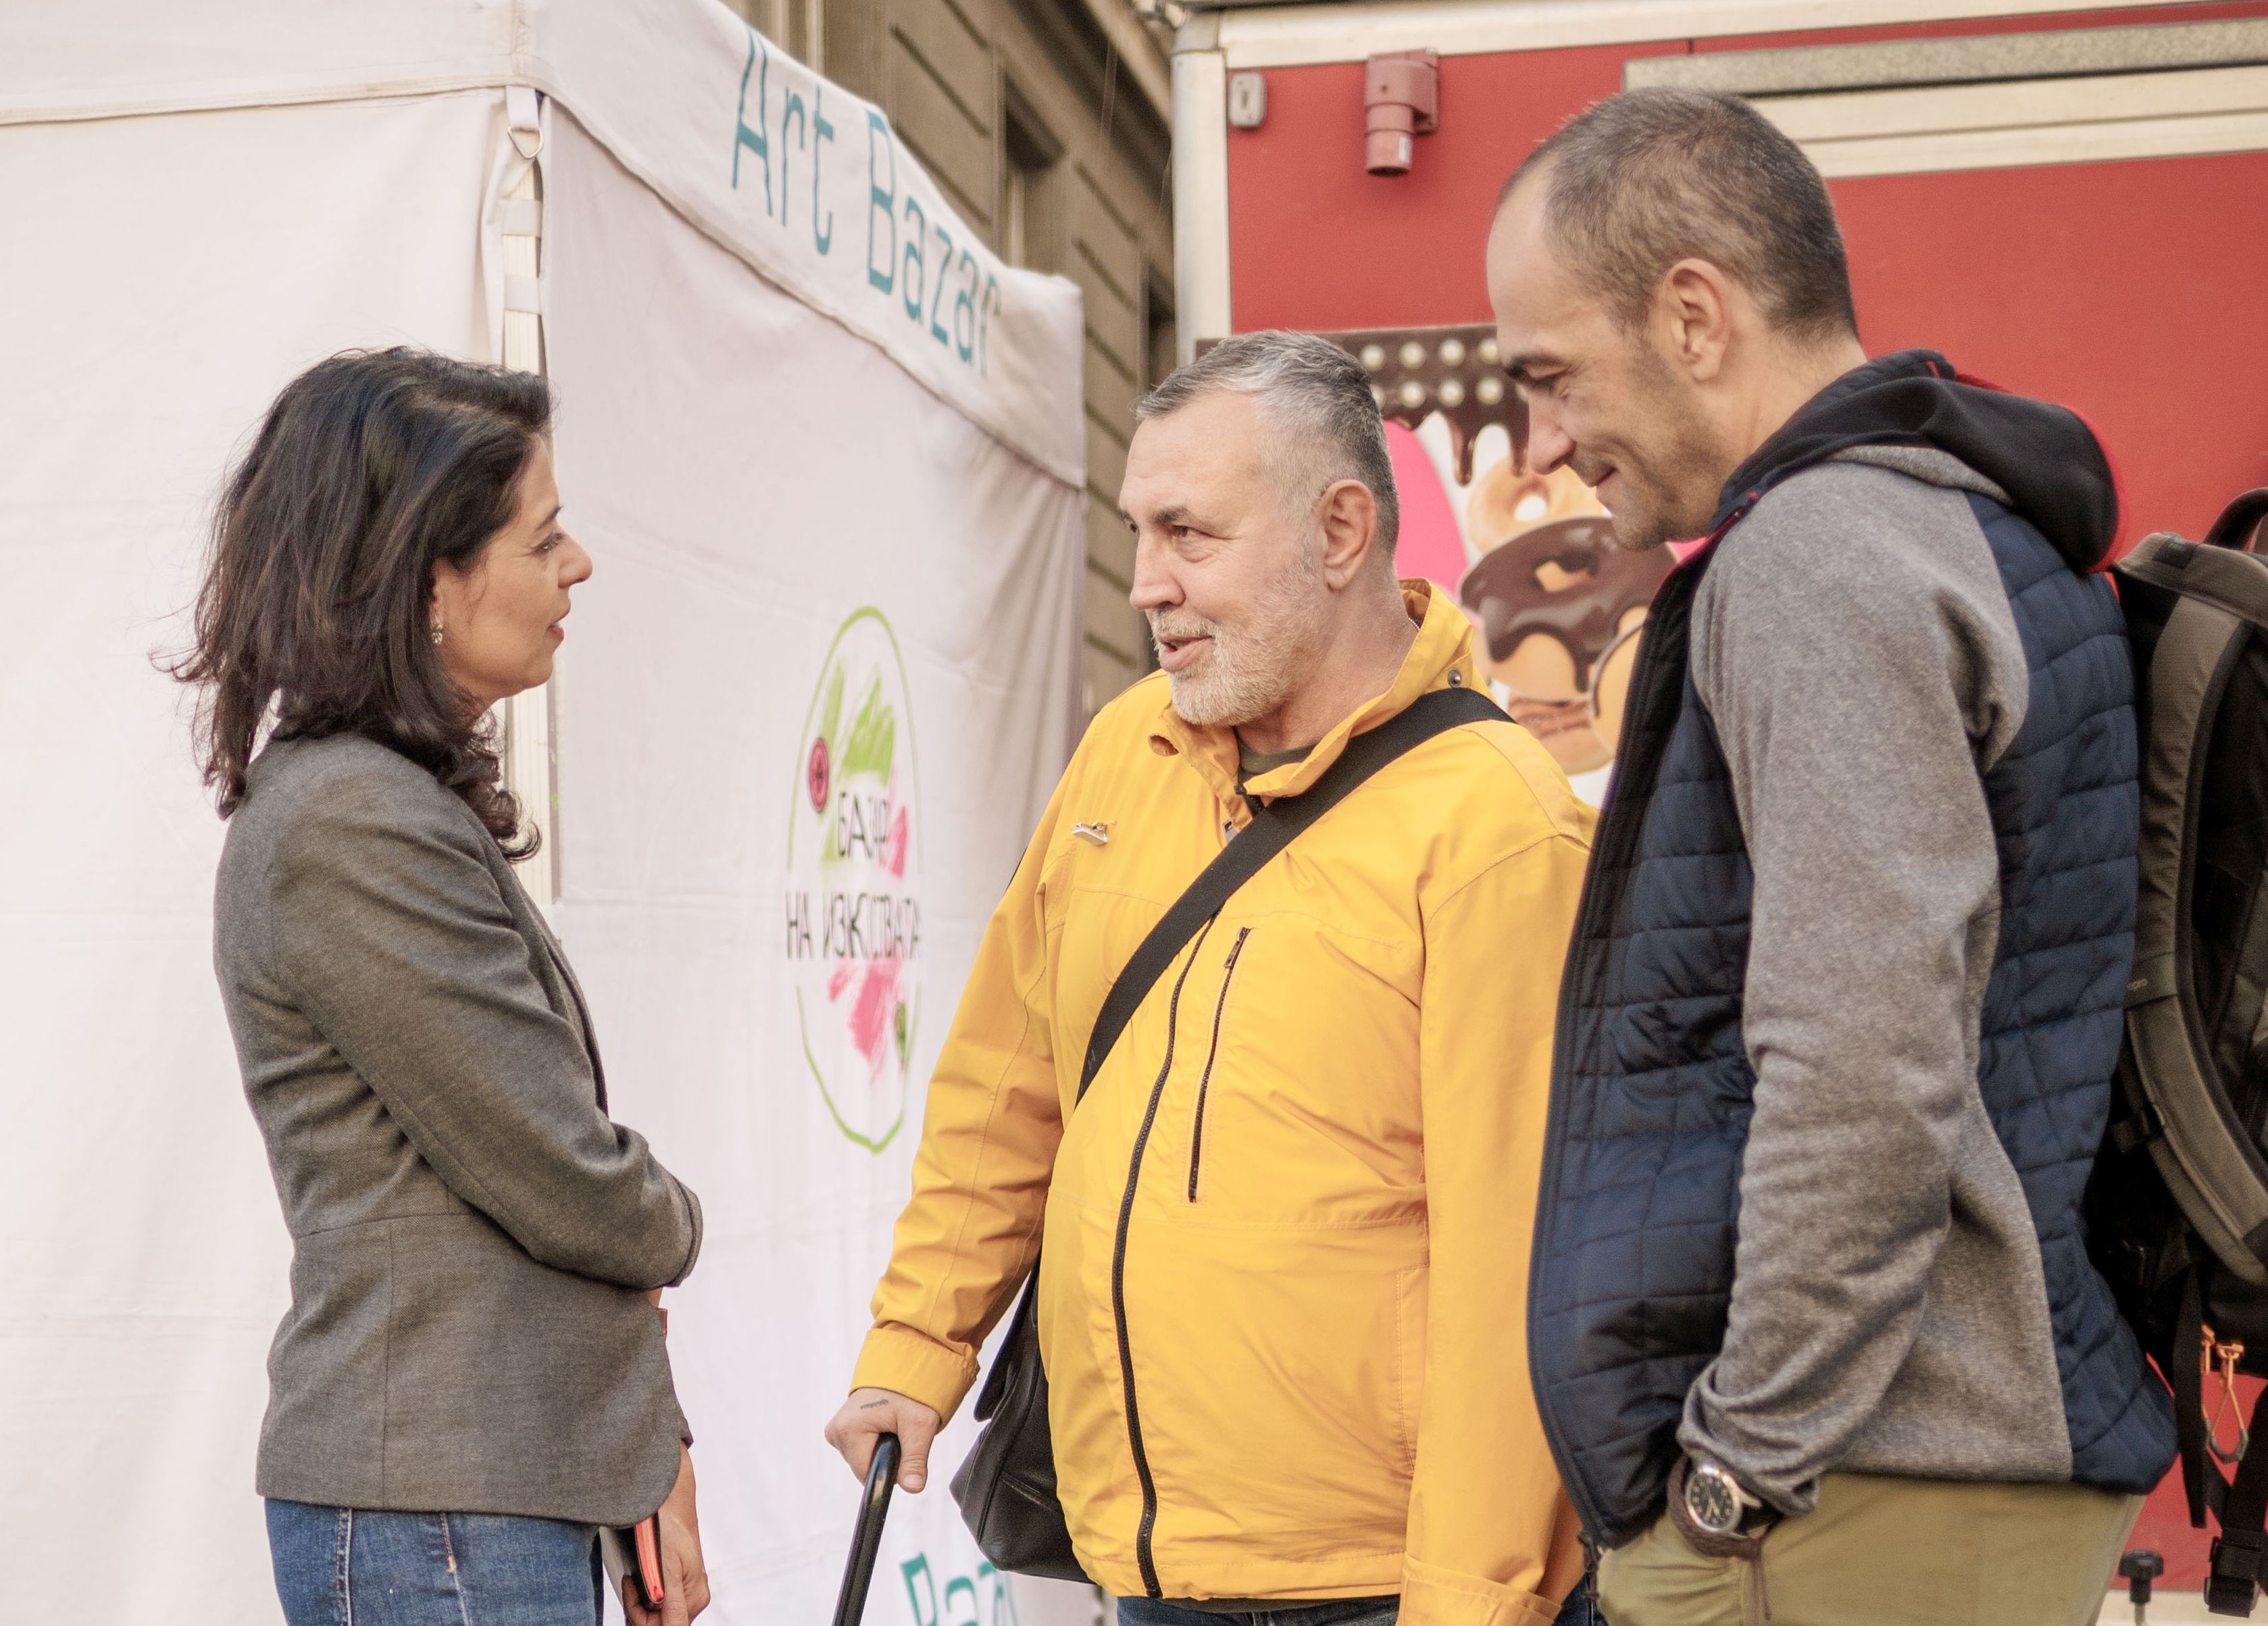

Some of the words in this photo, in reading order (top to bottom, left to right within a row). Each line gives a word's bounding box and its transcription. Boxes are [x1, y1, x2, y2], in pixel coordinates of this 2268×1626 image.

[732, 25, 834, 256] Art
[865, 107, 1001, 378] Bazar
[785, 891, 813, 960] НА
